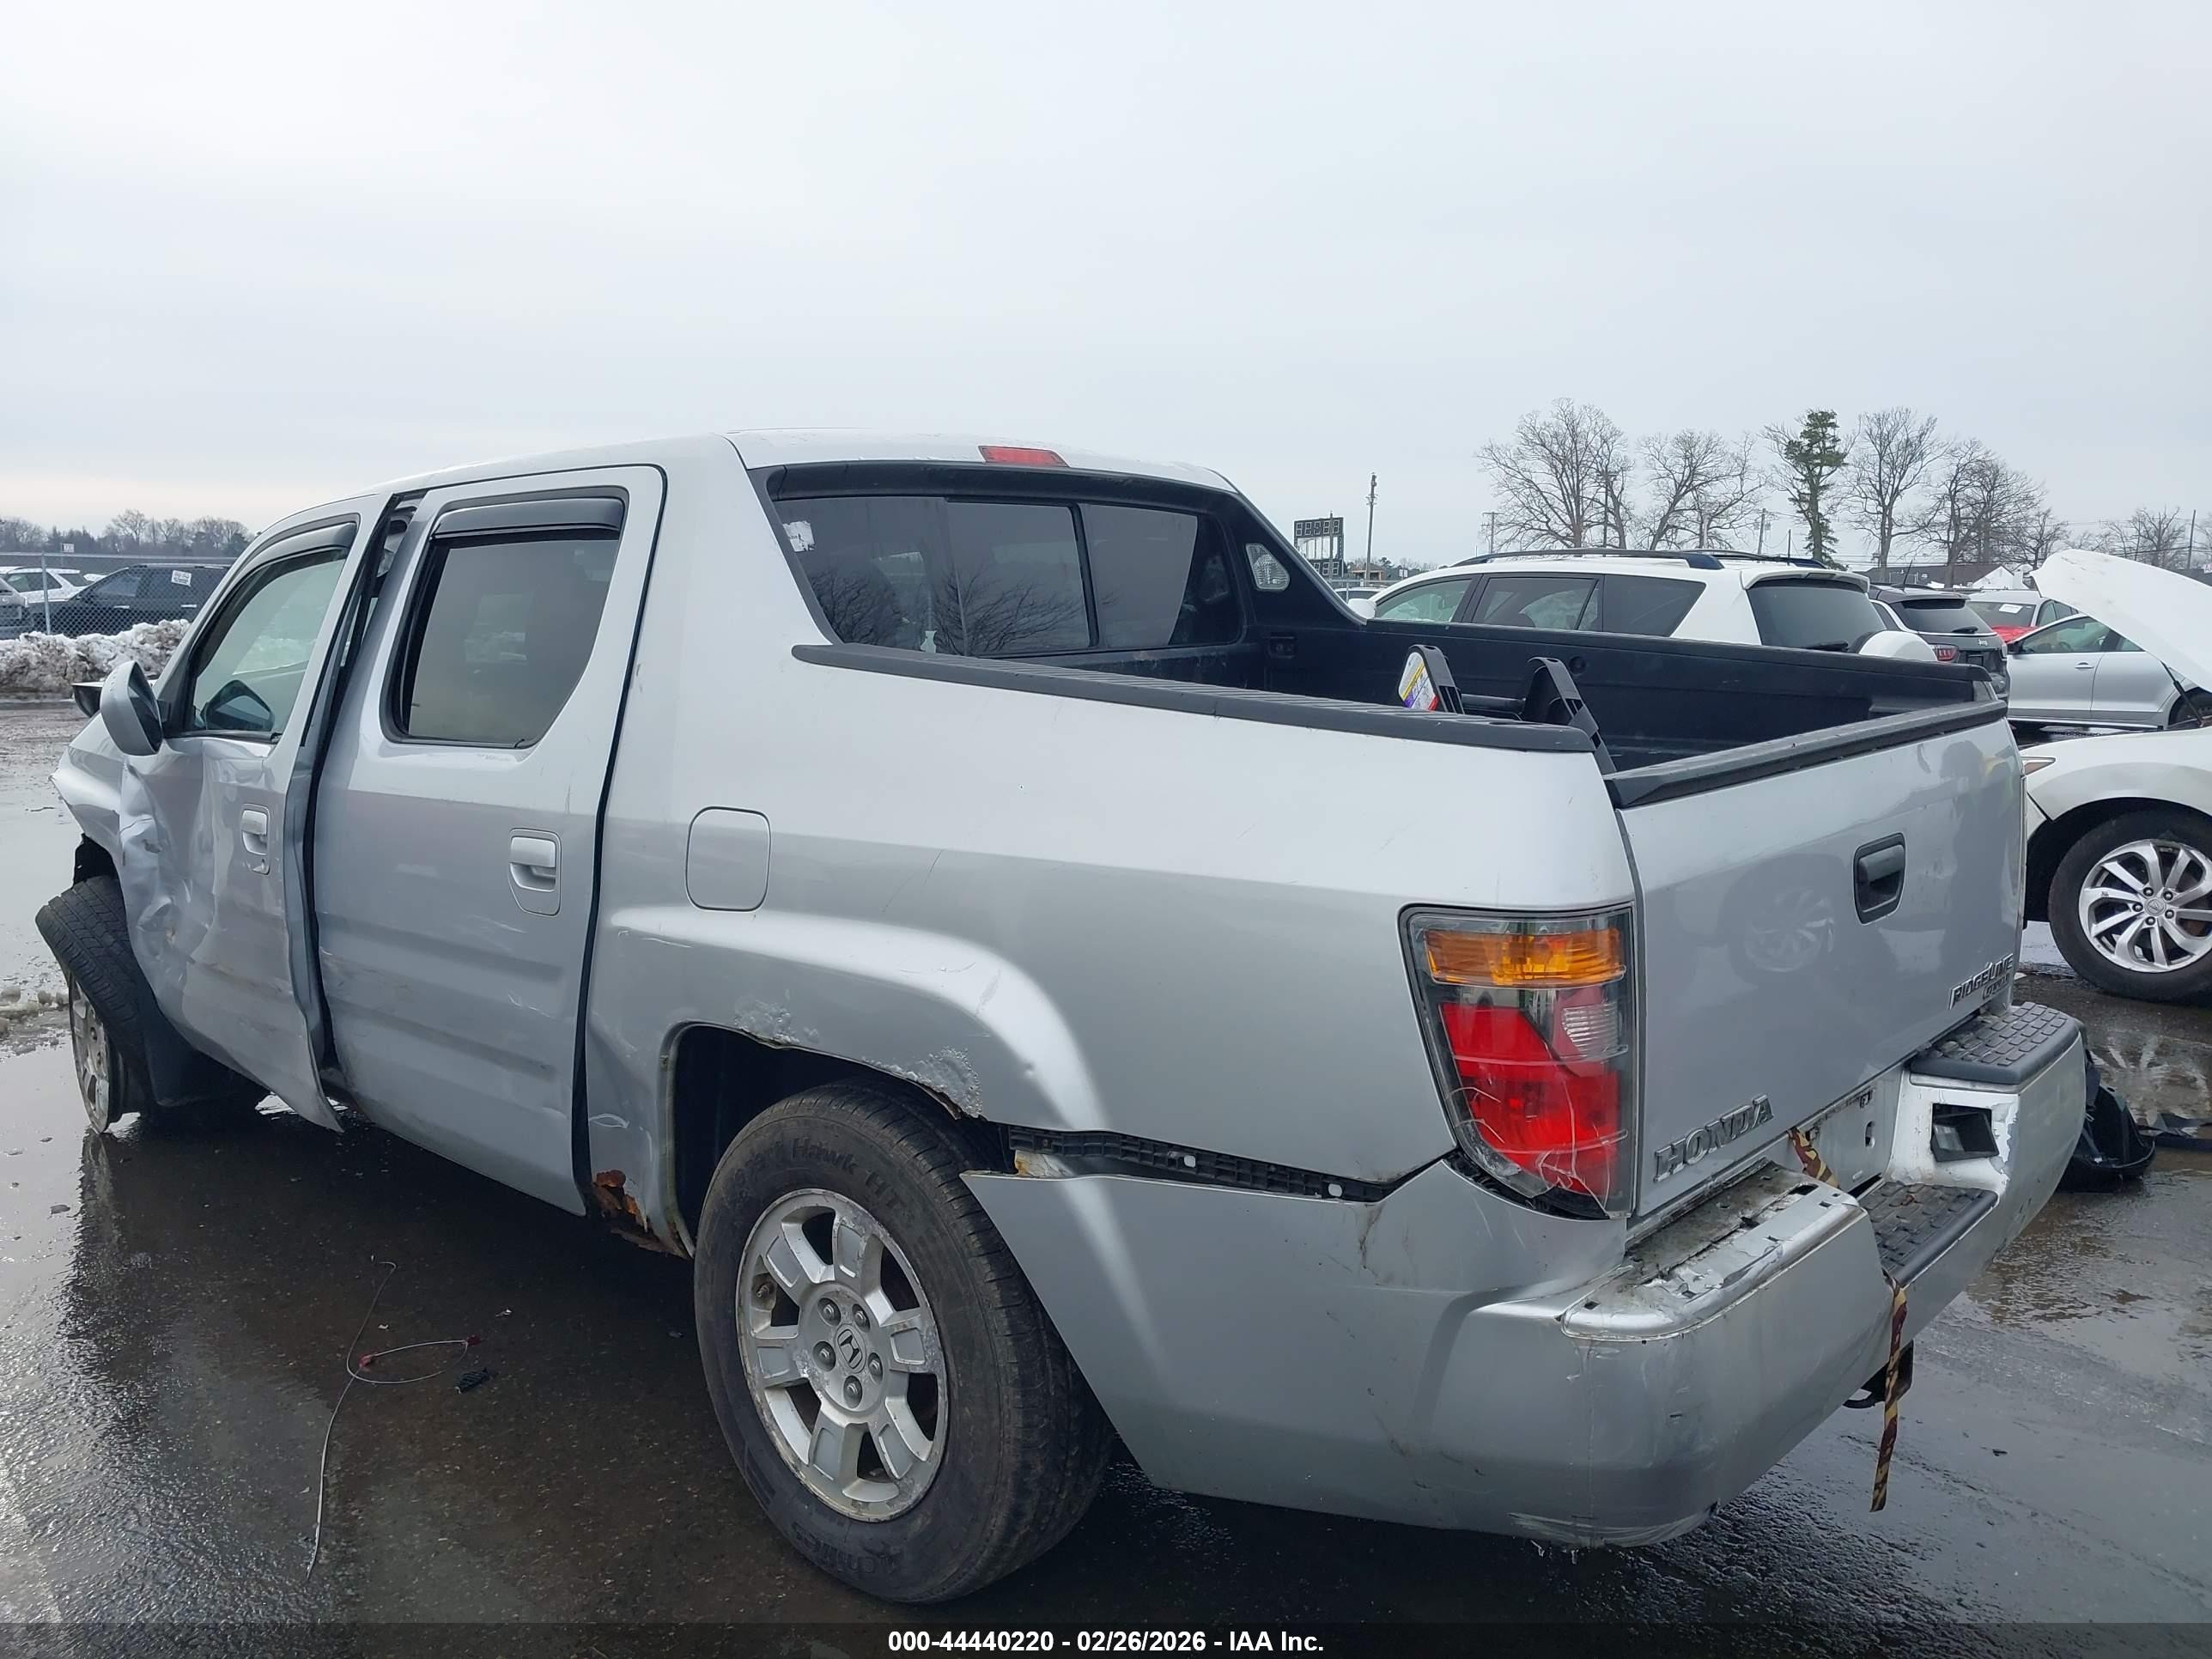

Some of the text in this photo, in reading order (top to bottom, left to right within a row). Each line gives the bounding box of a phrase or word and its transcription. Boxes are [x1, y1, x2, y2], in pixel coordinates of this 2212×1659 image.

[1948, 952, 2014, 1011] RIDGELINE
[792, 1137, 860, 1176] Hawk
[1653, 1092, 1775, 1183] HONDA
